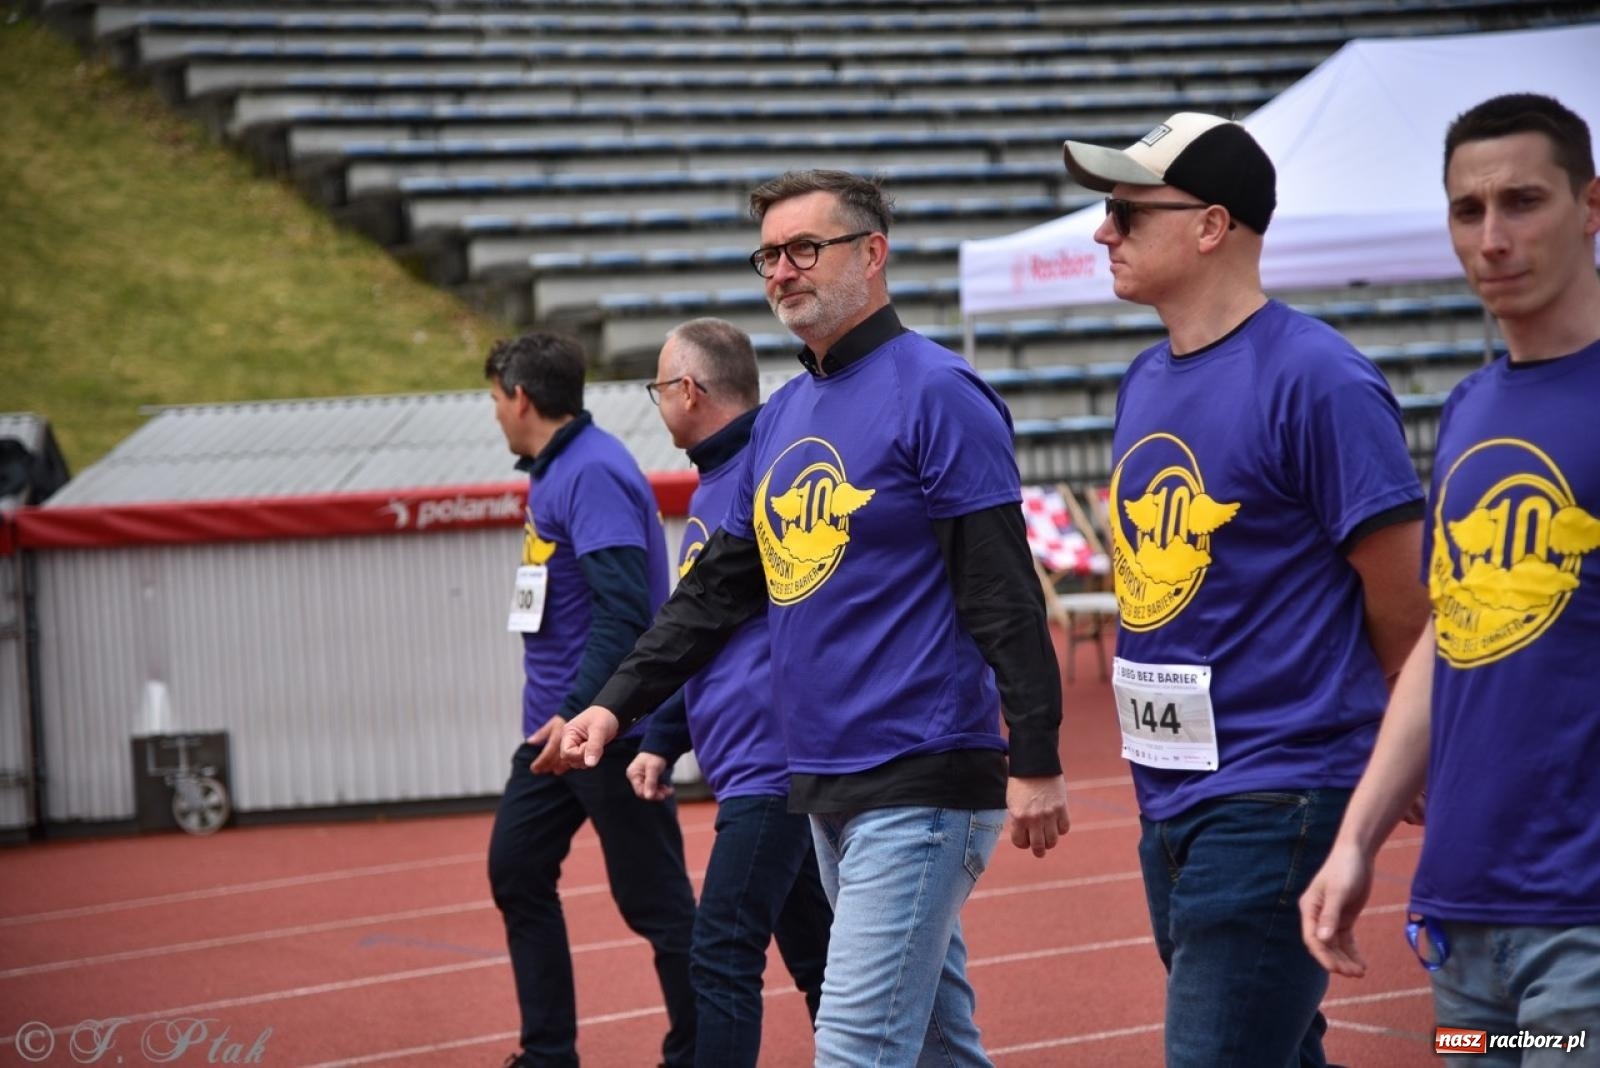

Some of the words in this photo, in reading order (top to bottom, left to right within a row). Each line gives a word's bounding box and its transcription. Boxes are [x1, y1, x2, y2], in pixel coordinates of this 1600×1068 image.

[417, 492, 523, 529] polanik
[797, 477, 833, 533] 10
[1153, 485, 1190, 548] 10
[1490, 496, 1551, 570] 10
[795, 567, 819, 592] BARIER
[1147, 591, 1175, 617] BARIER
[1137, 670, 1154, 682] BEZ
[1157, 672, 1198, 685] BARIER
[1130, 698, 1181, 735] 144
